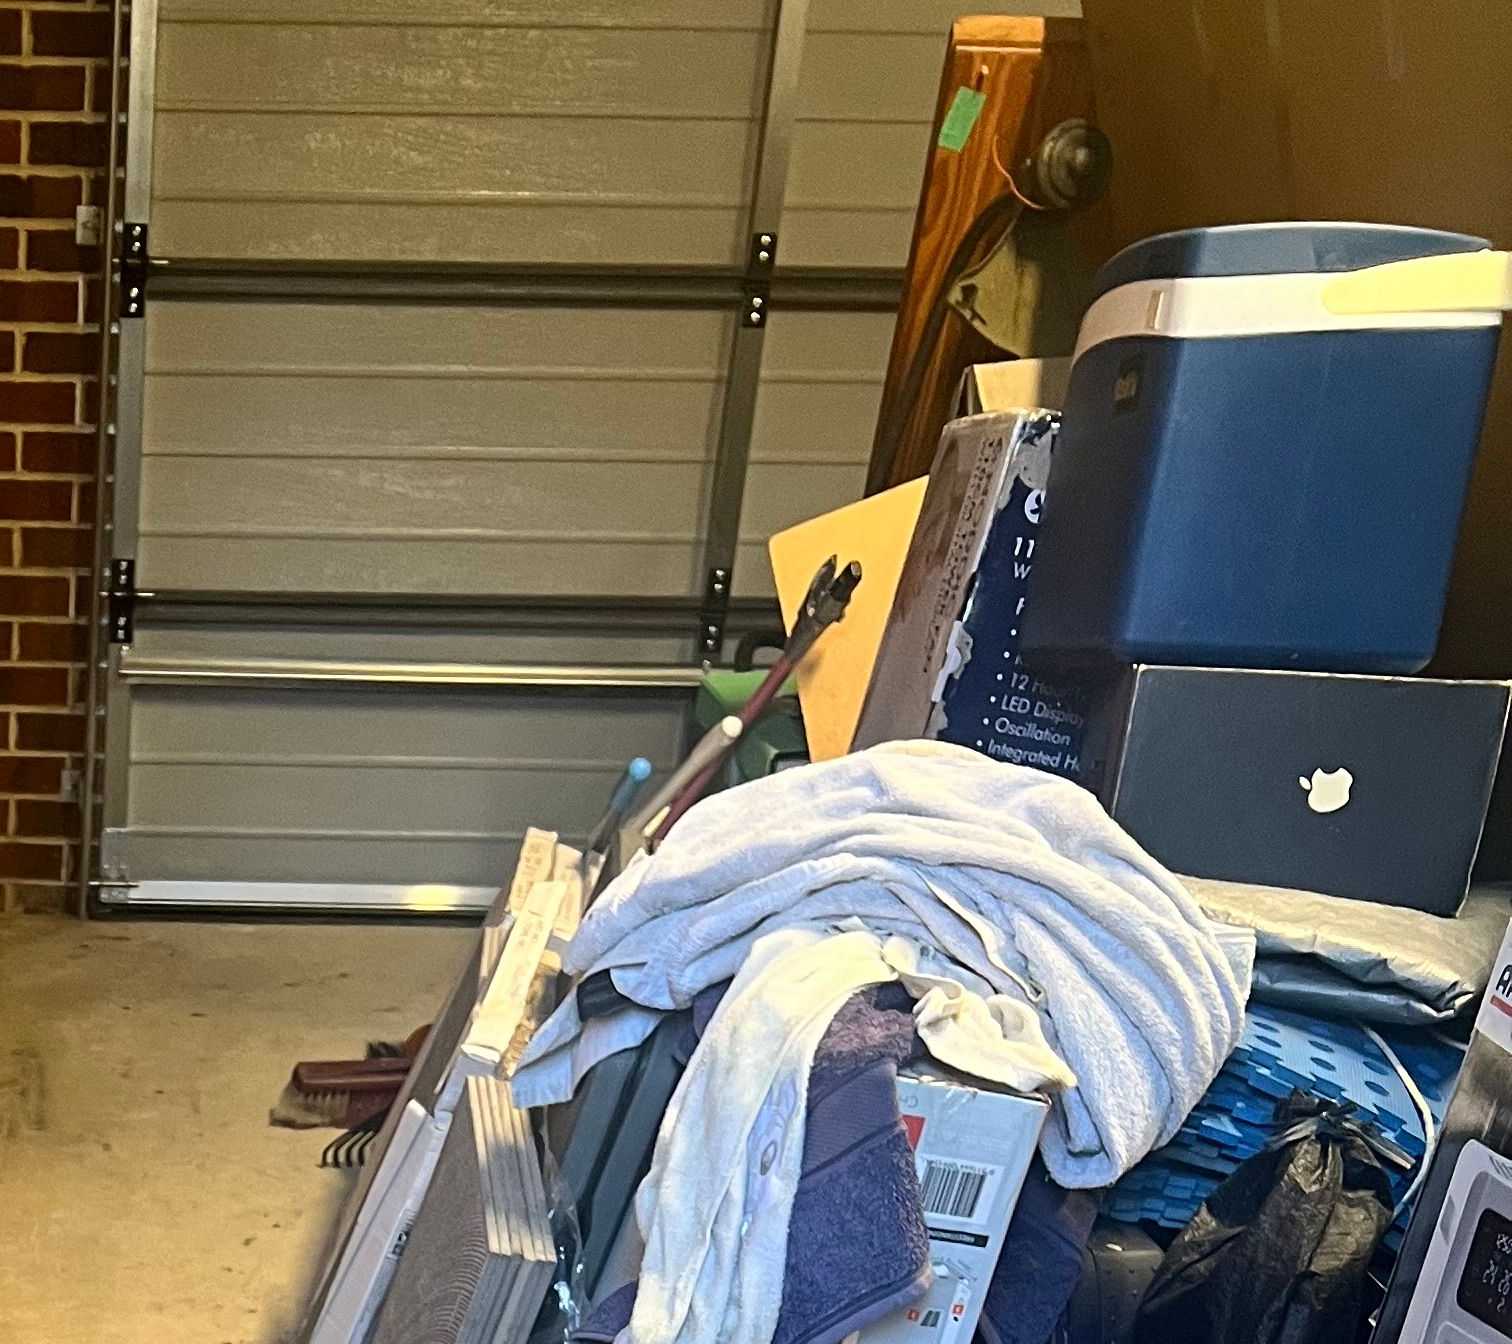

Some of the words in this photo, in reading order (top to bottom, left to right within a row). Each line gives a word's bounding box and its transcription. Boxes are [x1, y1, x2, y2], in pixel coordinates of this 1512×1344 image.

[1011, 672, 1029, 690] 12
[1001, 694, 1031, 714] LED
[1033, 701, 1085, 729] Display
[994, 716, 1071, 747] Oscillation
[988, 738, 1062, 768] Integrated
